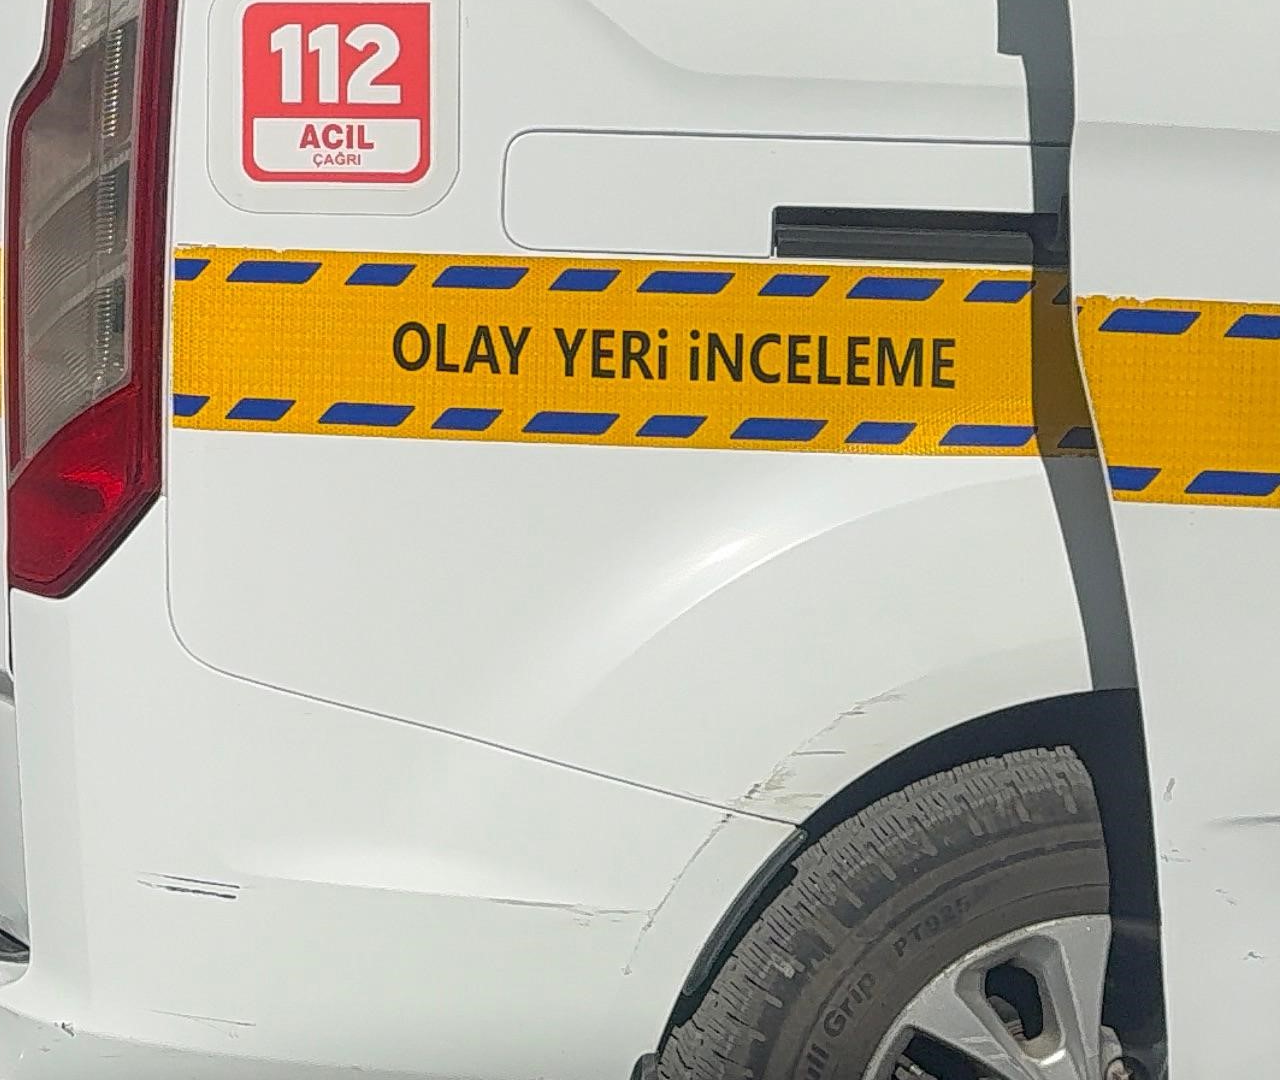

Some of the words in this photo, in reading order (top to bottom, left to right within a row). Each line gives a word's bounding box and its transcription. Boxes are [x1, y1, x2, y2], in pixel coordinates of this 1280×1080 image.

[270, 23, 401, 104] 112
[313, 151, 362, 168] ÇAĞRI
[392, 321, 532, 375] OLAY
